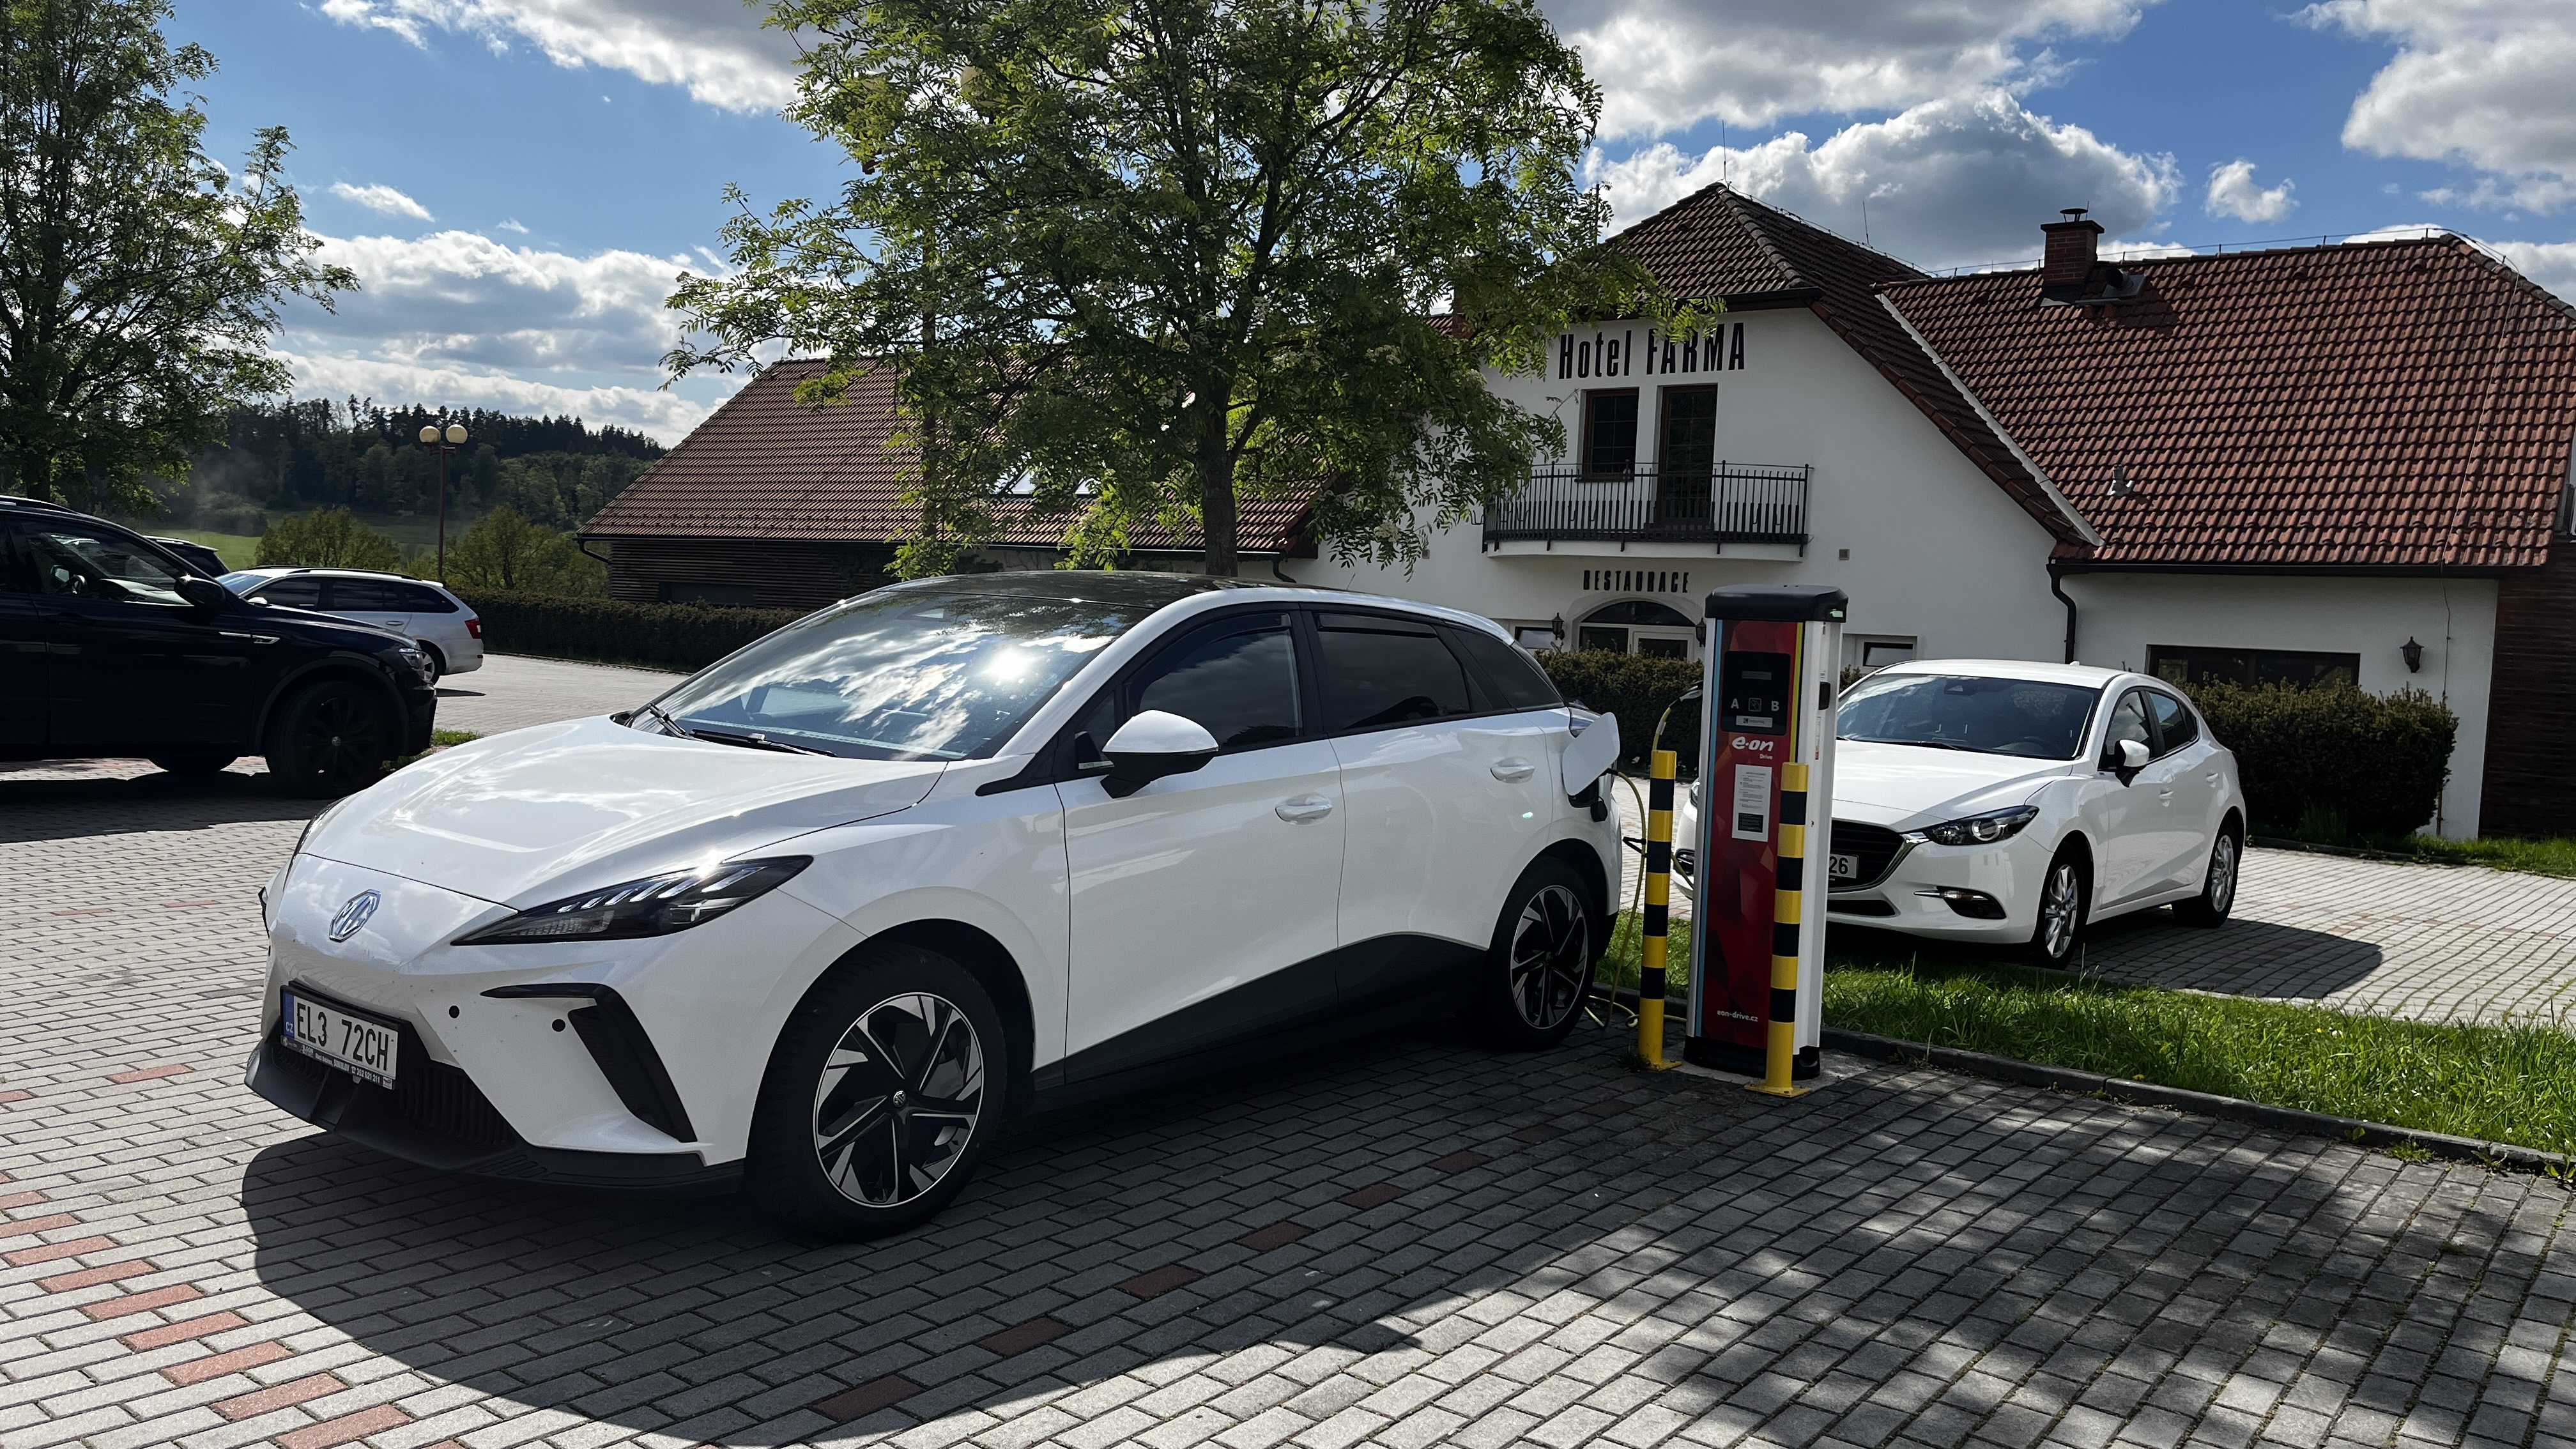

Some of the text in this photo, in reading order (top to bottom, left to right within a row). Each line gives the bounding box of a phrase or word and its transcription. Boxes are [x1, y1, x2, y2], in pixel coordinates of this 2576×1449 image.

[1559, 323, 1745, 379] Hotel FARMA
[1583, 570, 1689, 593] RESTAURACE
[1731, 698, 1779, 711] A B
[1829, 856, 1848, 875] 26
[1717, 1010, 1758, 1022] eon-drive.cz
[286, 1022, 293, 1034] CZ
[297, 1002, 388, 1071] EL3 72CH
